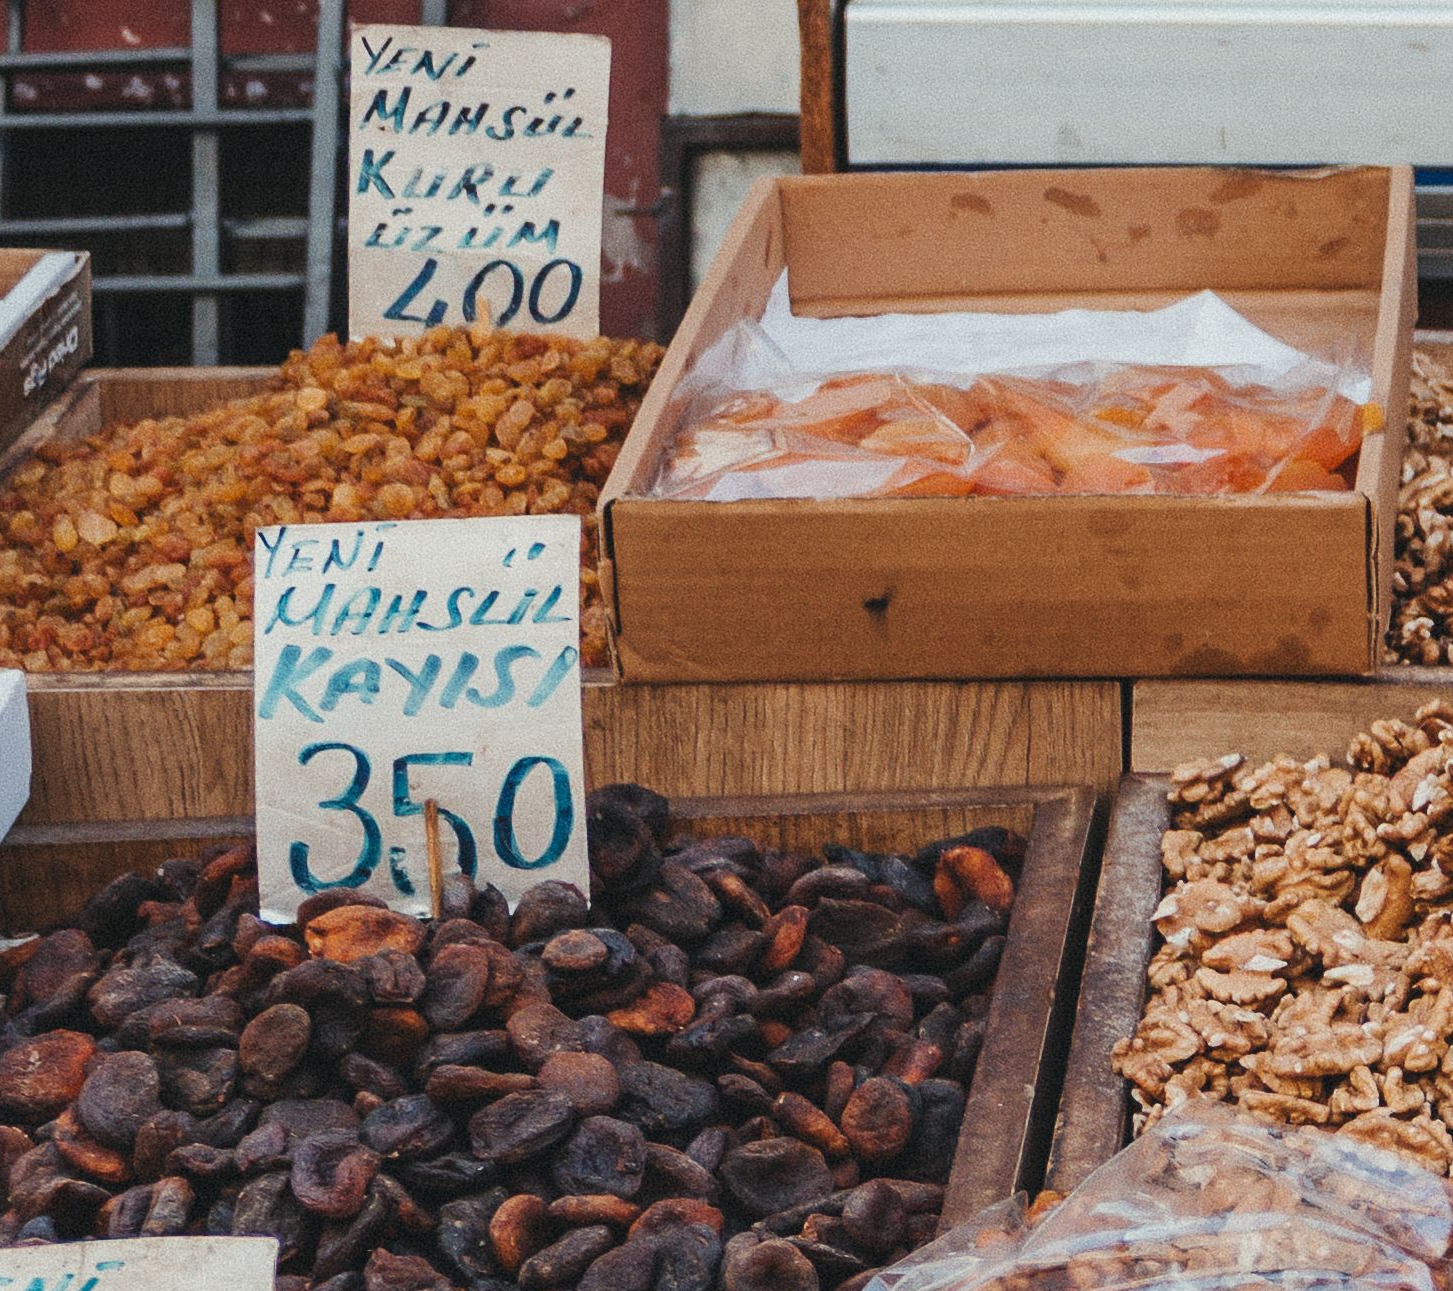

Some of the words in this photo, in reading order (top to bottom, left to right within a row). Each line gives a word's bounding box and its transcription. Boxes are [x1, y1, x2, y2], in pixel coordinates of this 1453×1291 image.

[361, 36, 490, 81] YENİ
[359, 87, 594, 140] MAHSÜL
[356, 149, 555, 204] KURU
[363, 203, 561, 254] ÜZÜM
[382, 257, 583, 328] 400
[258, 524, 397, 579] YENİ
[263, 542, 573, 636] MAHSÜL
[258, 644, 578, 724] KAYISI
[289, 741, 576, 897] 350
